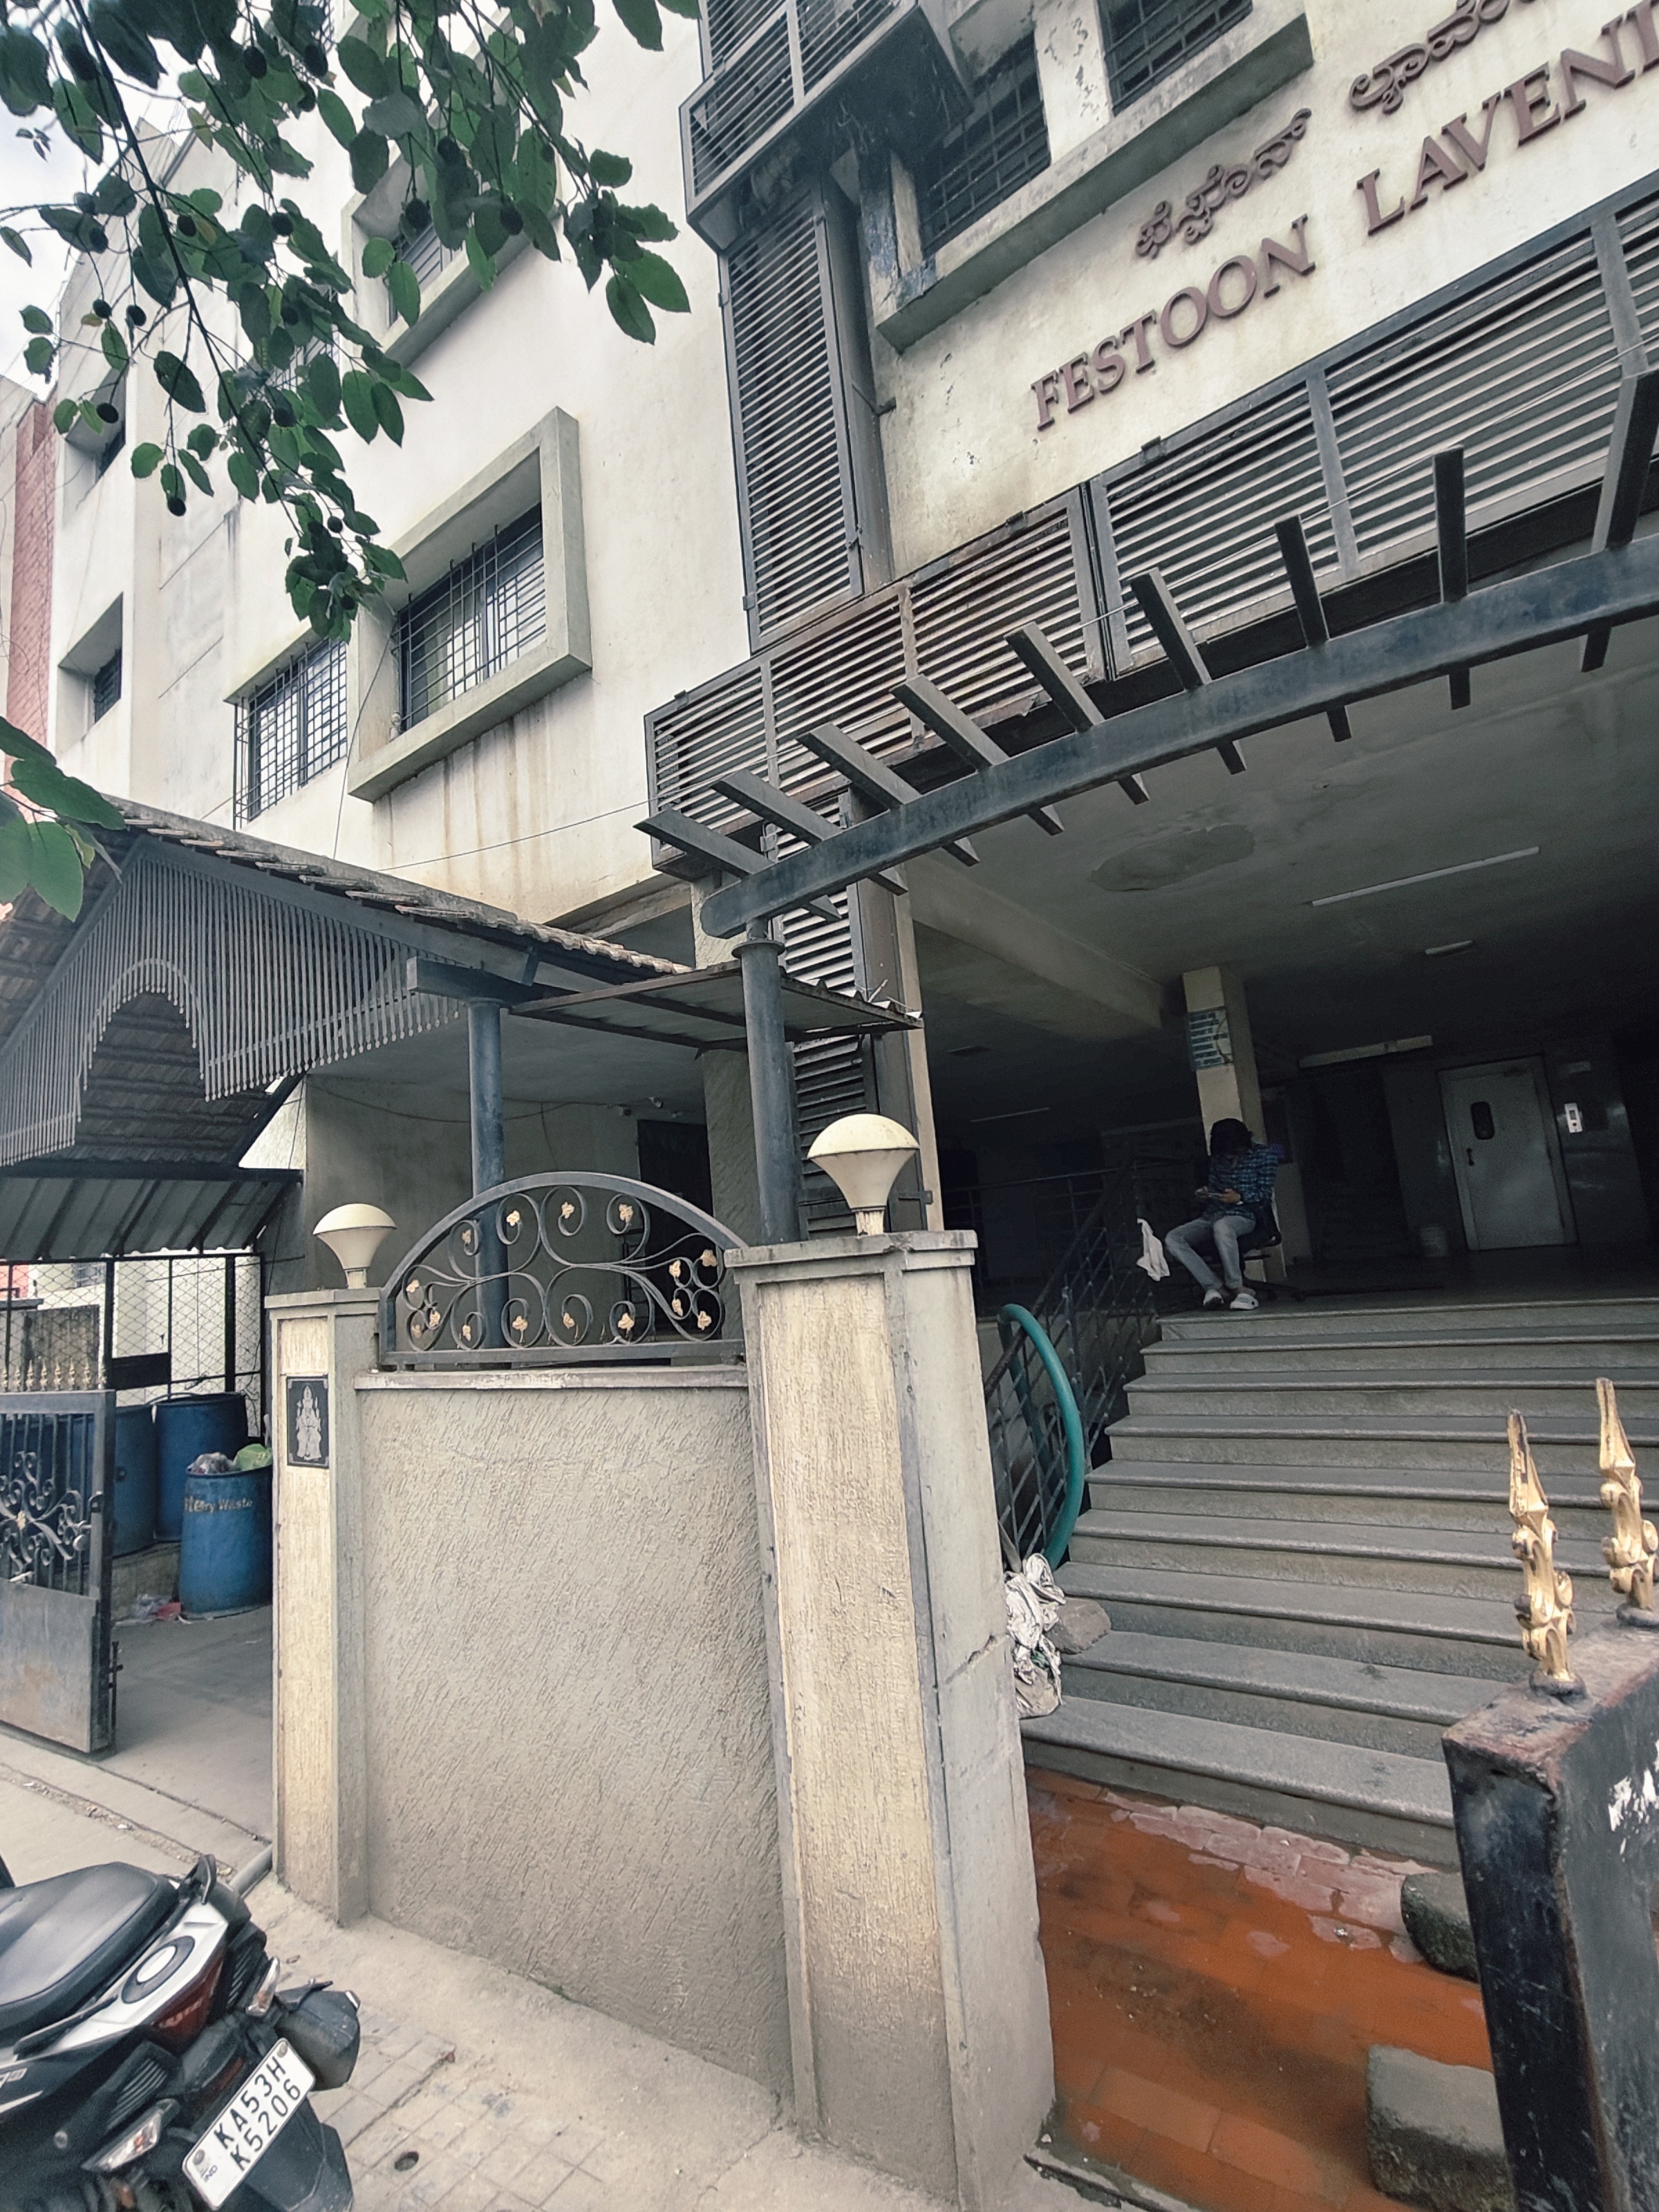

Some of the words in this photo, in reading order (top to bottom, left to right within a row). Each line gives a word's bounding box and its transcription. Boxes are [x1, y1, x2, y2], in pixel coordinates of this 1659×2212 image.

[1030, 214, 1316, 432] FESTOON
[214, 2056, 285, 2150] KA53H
[230, 2079, 301, 2171] K5206
